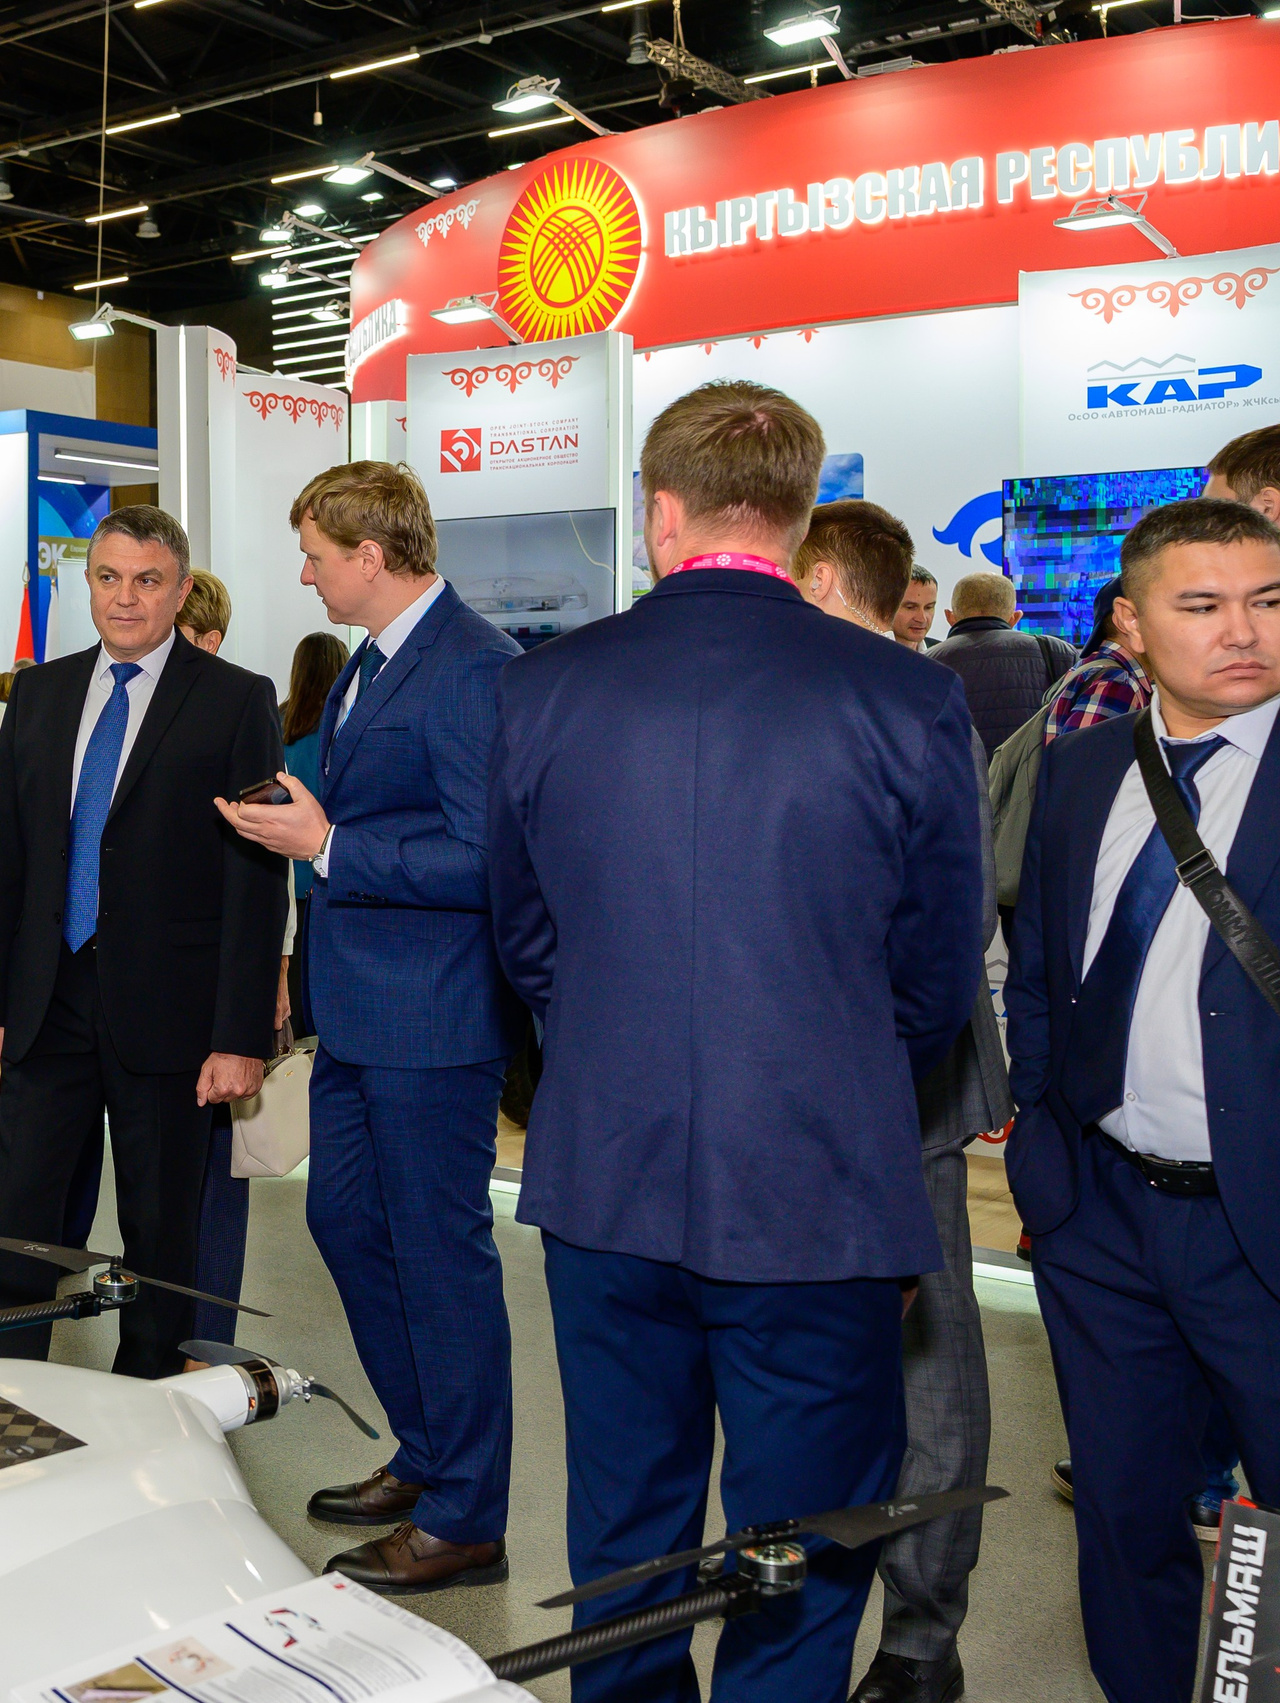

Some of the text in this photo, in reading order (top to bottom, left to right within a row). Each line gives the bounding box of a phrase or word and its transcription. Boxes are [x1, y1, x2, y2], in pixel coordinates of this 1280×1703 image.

[664, 119, 1279, 258] КЫРГЫЗСКАЯ РЕСПУБЛИ
[1068, 411, 1099, 421] ОсОО
[1101, 400, 1240, 419] «АВТОМАШ-РАДИАТОР»
[490, 425, 579, 438] TRANSNATIONAL CORPORATION
[509, 421, 549, 429] JOINT-STOCK
[552, 417, 579, 425] COMPANY
[489, 433, 579, 455] DASTAN
[517, 455, 552, 463] АКЦИОНЕРНОЕ
[1212, 1523, 1268, 1703] ЕЛЬМАШ
